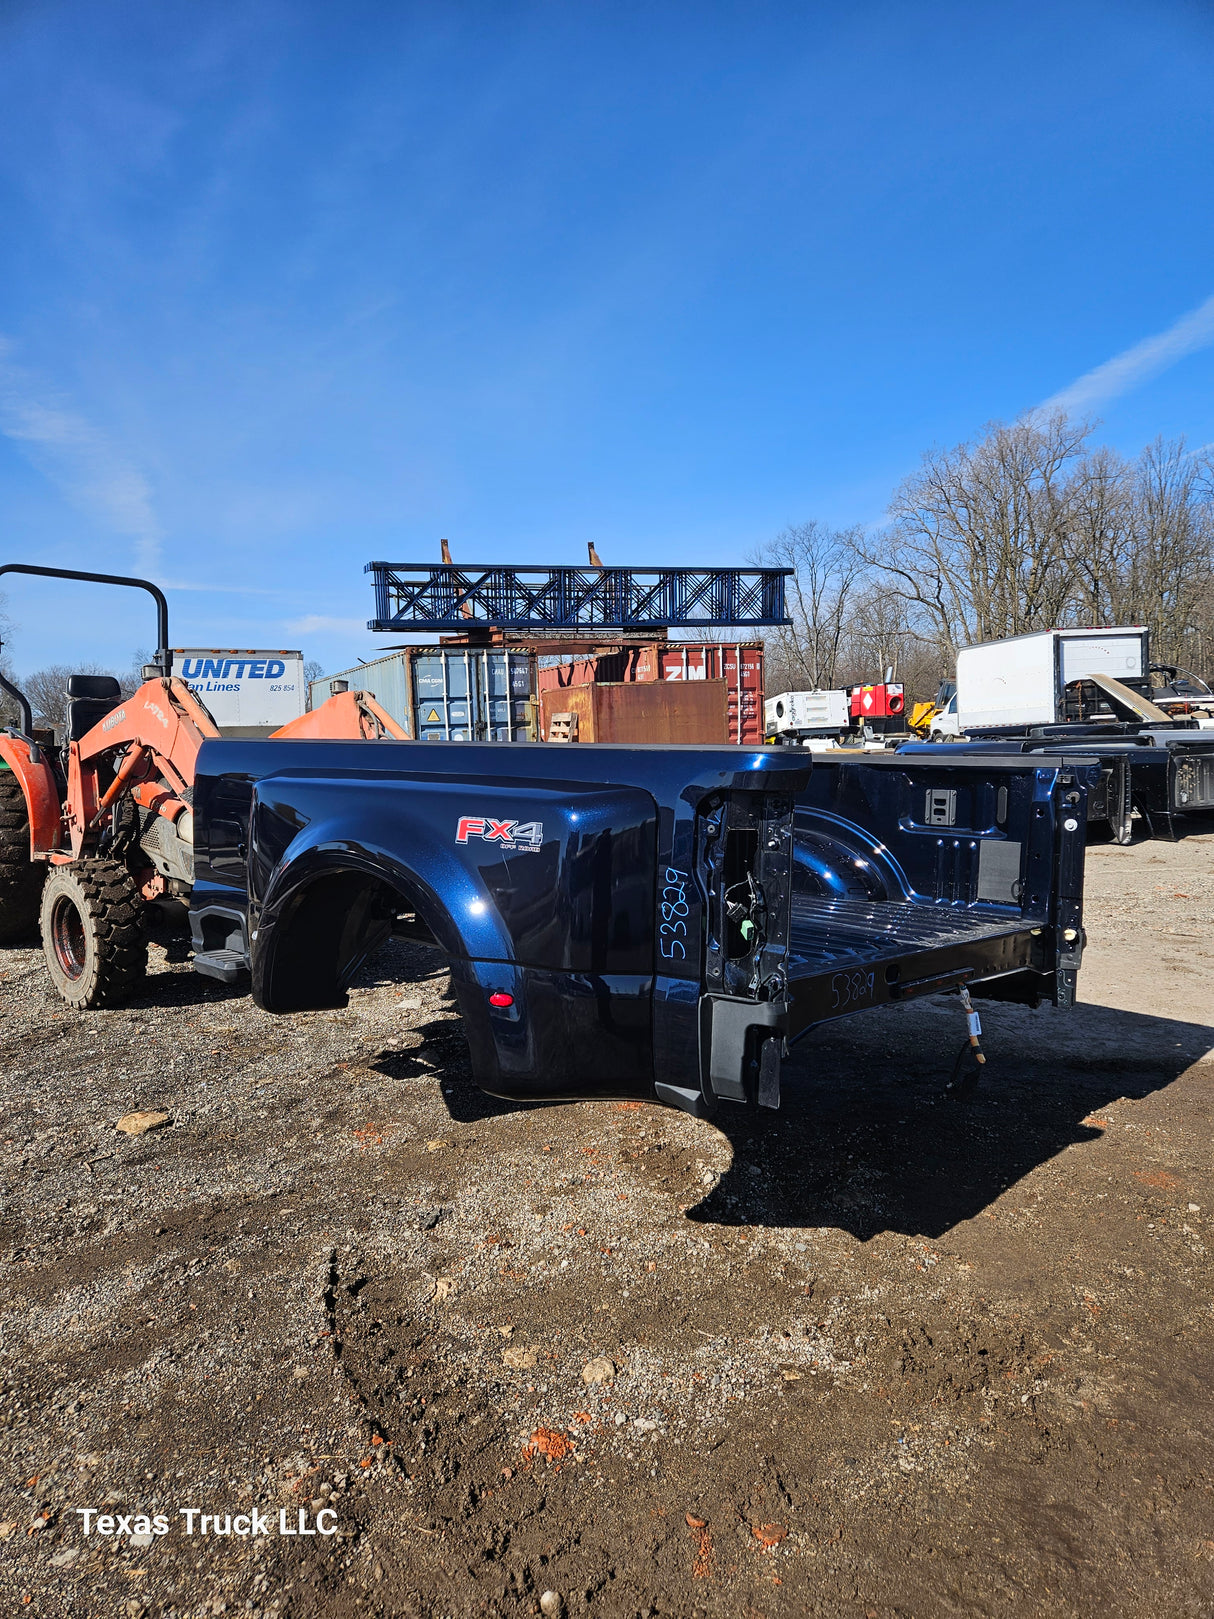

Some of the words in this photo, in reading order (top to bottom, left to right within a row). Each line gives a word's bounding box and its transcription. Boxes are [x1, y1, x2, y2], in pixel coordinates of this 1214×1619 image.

[182, 659, 285, 679] UNITED
[187, 682, 203, 691] an
[206, 681, 241, 692] Lines
[455, 816, 543, 847] FX4
[660, 867, 689, 960] 53829
[832, 968, 874, 1008] 53829
